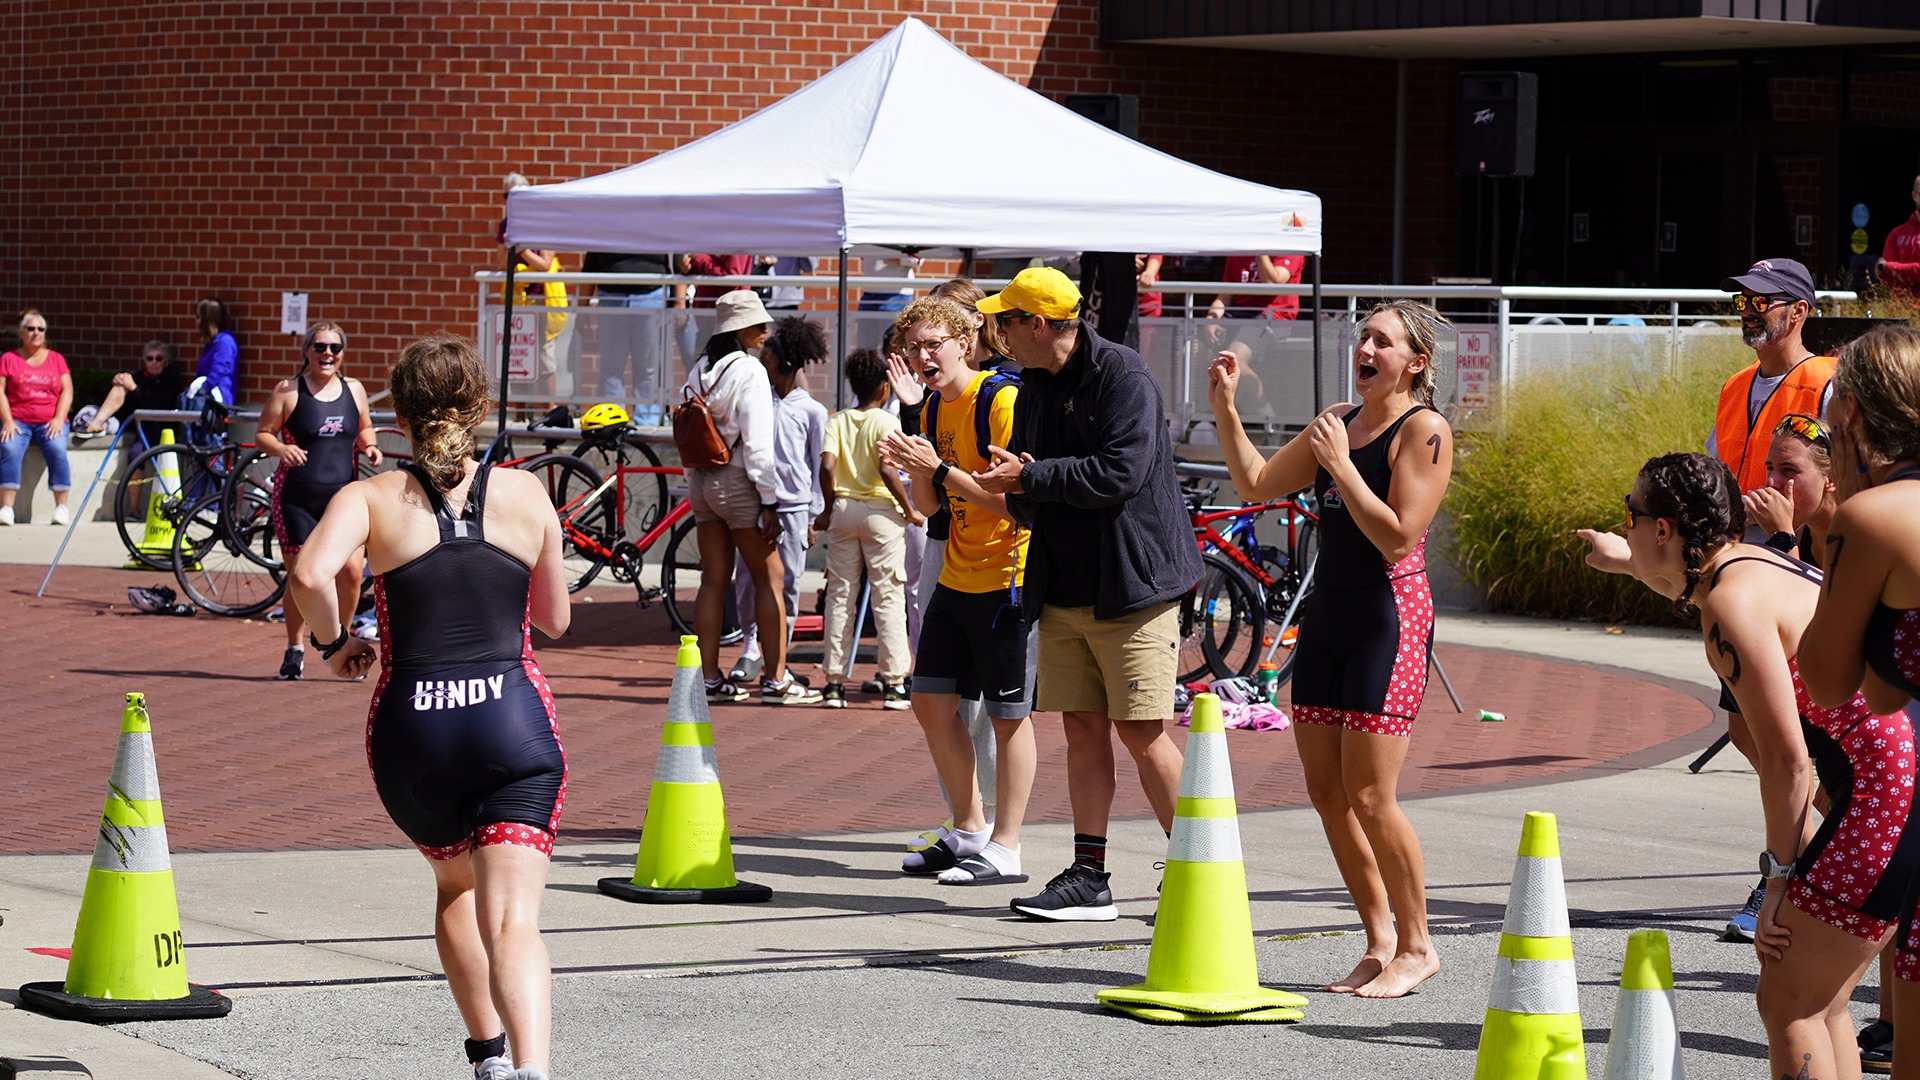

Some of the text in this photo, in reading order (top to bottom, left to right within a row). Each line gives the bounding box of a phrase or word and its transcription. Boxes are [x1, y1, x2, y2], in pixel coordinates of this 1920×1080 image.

[497, 333, 535, 346] PRKING
[1467, 338, 1480, 352] NO
[1457, 355, 1490, 369] PARKING
[1427, 433, 1441, 465] 1
[1708, 622, 1741, 687] 3
[412, 674, 504, 711] UINDY
